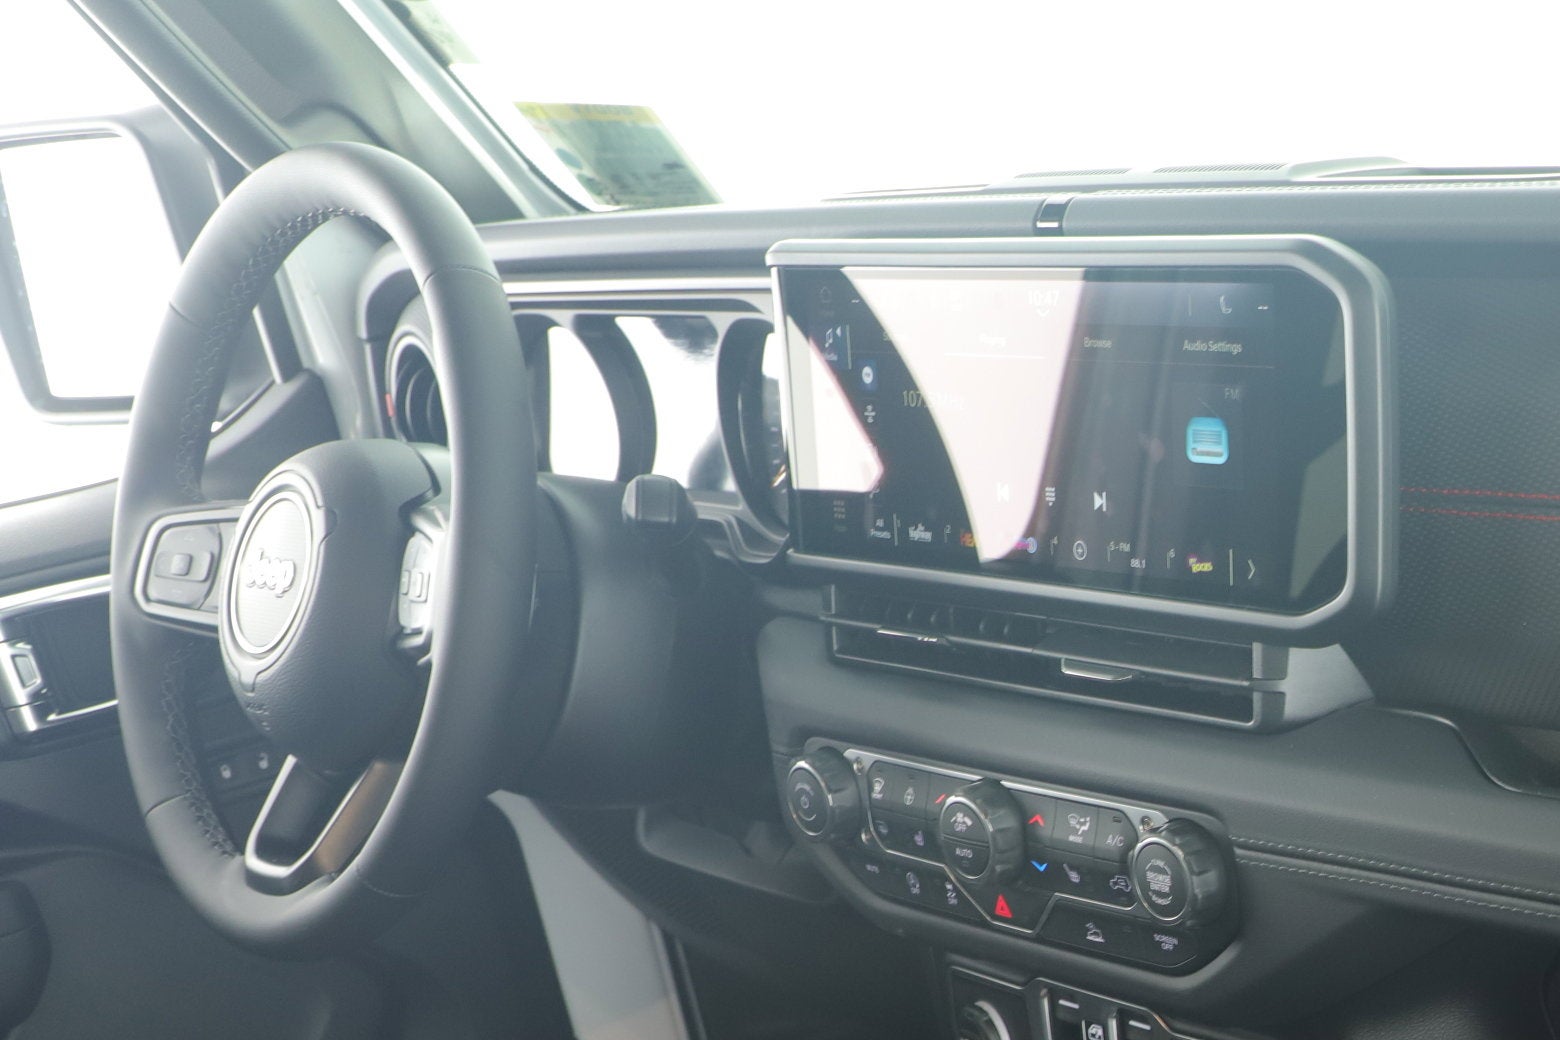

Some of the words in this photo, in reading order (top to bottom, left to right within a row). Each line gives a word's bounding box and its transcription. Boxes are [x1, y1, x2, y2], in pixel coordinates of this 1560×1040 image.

[1083, 336, 1112, 349] Browse
[1182, 339, 1207, 352] Audio
[1208, 340, 1242, 355] Settings
[1105, 834, 1124, 847] A/C
